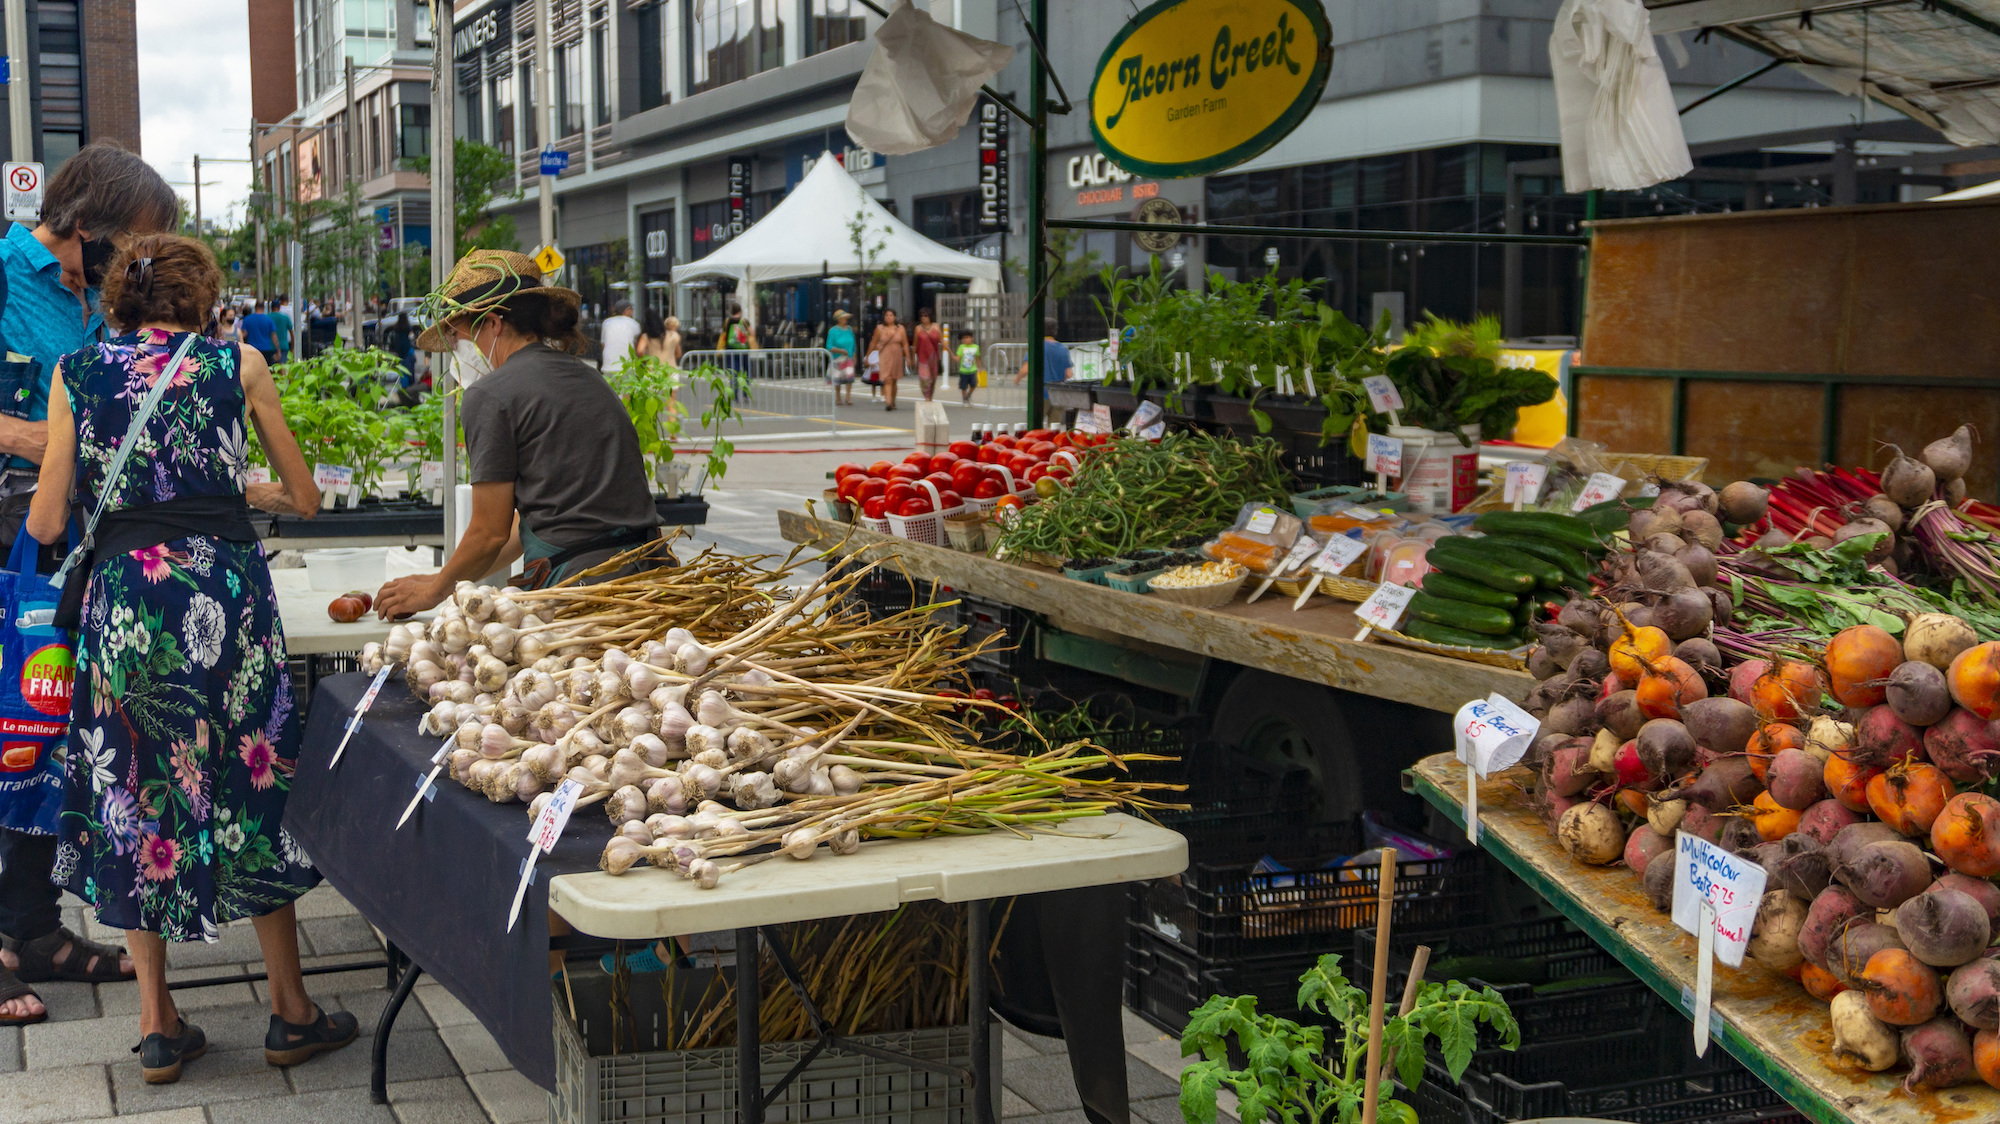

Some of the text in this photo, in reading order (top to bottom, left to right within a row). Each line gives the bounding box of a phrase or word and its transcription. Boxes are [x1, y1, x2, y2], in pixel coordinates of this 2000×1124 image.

[454, 10, 498, 59] INNERS
[1106, 12, 1301, 129] Acorn Creek
[1167, 97, 1227, 122] Garden Farm
[981, 103, 997, 226] industria
[1000, 149, 1008, 224] pizzeria
[1078, 182, 1159, 205] CHOCOLATE BISTRO
[3, 720, 16, 731] Le
[17, 723, 60, 734] meilleur
[1465, 719, 1487, 738] $5
[1469, 703, 1520, 737] Red Beets
[1681, 836, 1740, 882] Multicolour
[1690, 862, 1712, 898] Beets
